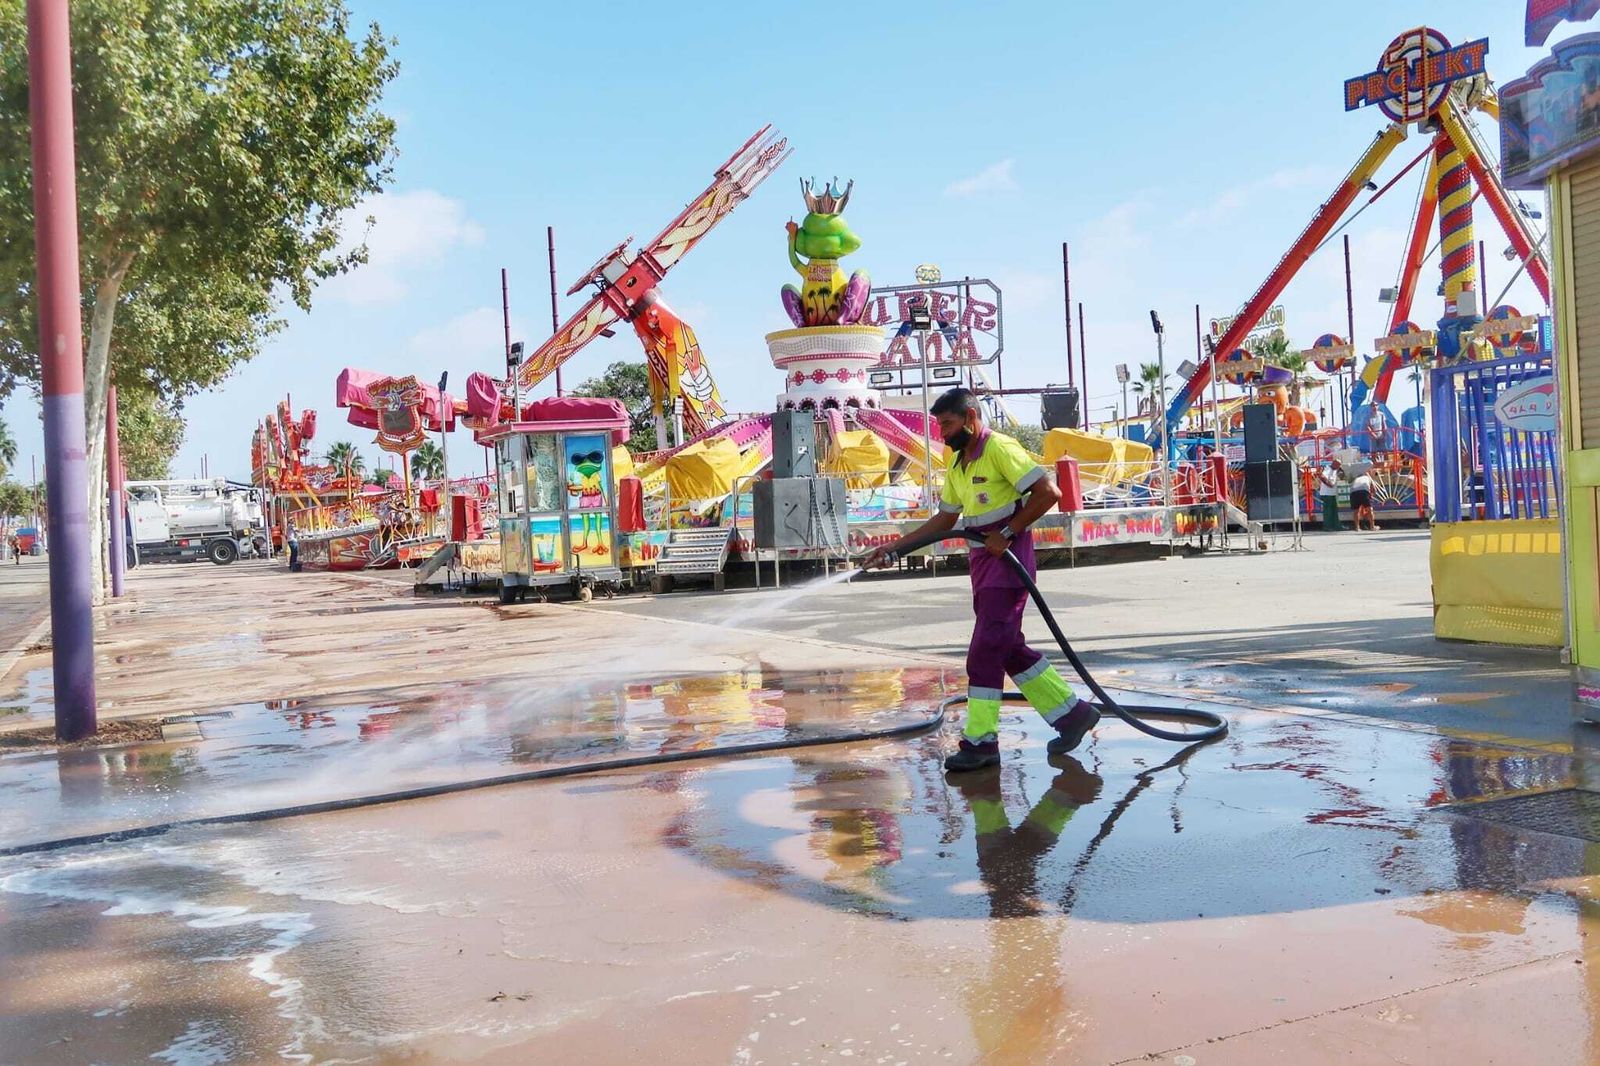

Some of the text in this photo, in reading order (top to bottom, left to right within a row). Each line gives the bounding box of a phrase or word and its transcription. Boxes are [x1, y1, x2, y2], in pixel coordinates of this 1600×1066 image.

[1347, 42, 1487, 107] PROJEKT
[862, 290, 997, 331] UPER
[872, 329, 983, 368] ANA
